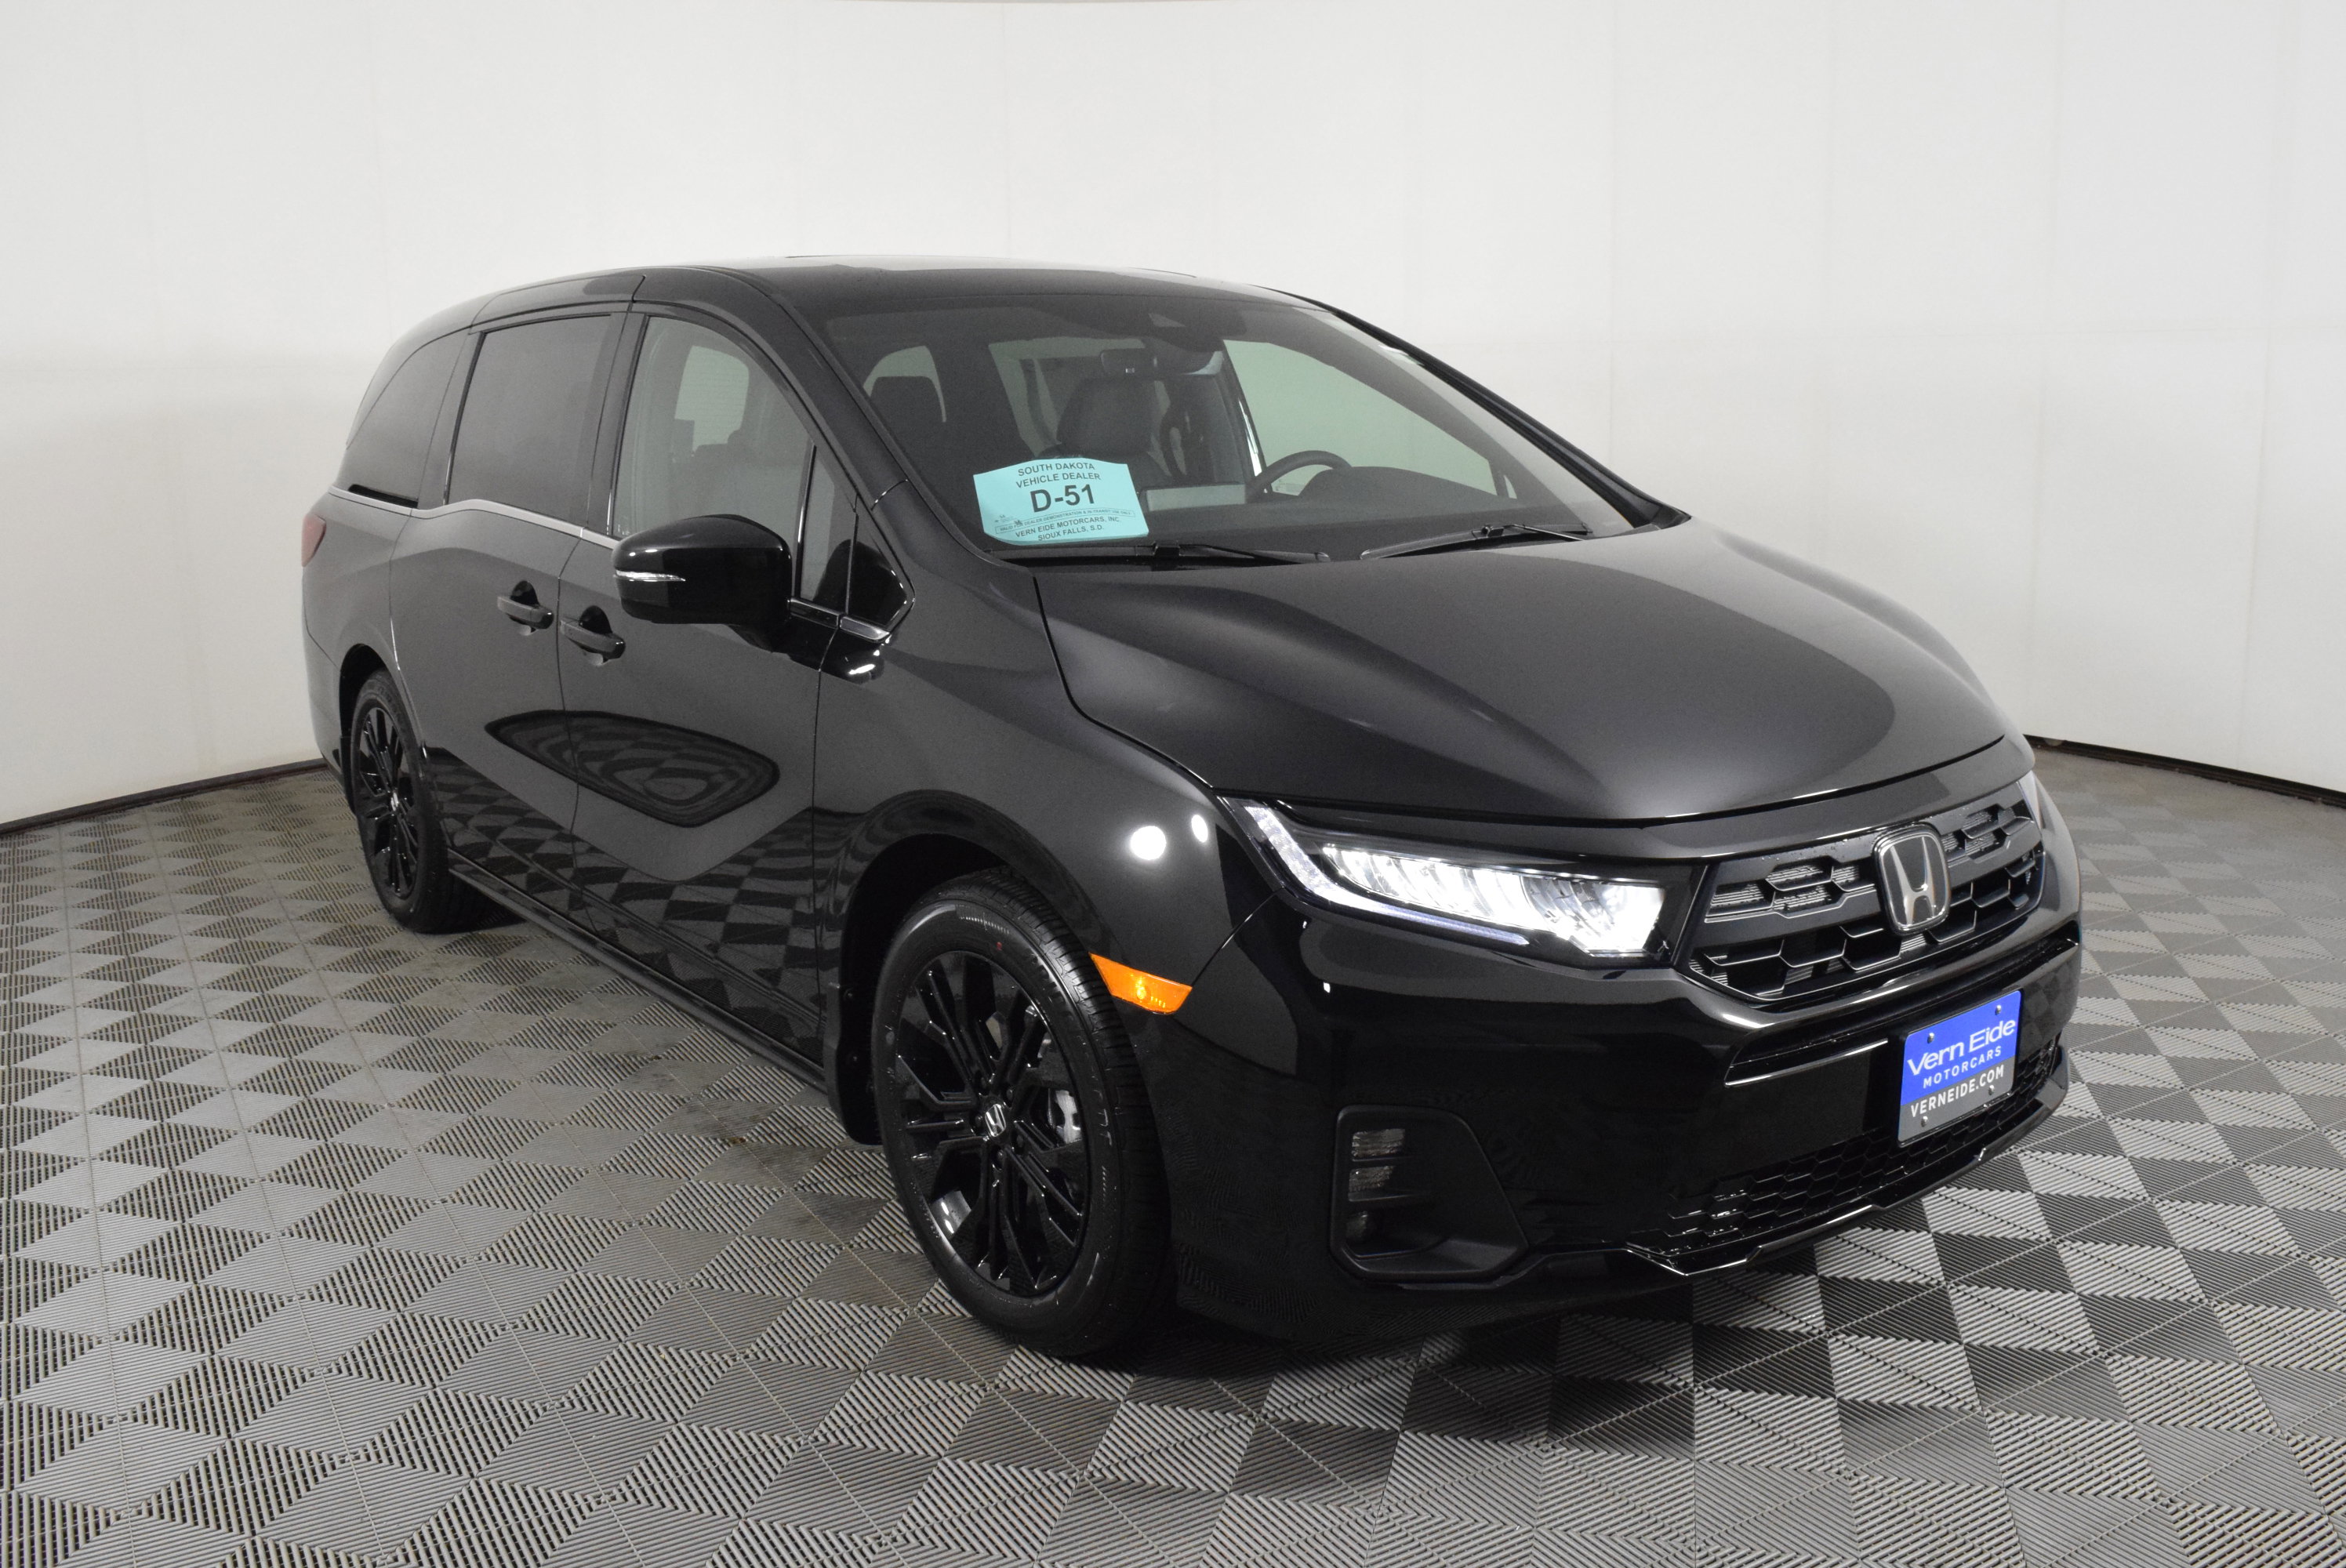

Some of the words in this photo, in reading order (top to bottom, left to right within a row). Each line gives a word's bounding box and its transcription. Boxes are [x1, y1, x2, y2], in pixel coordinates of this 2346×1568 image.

[1016, 474, 1059, 488] VEHICLE
[1062, 472, 1101, 481] DEALER
[1018, 463, 1053, 477] SOUTH
[1030, 484, 1095, 513] D-51
[1043, 510, 1082, 521] DEMONSTRATION
[1016, 528, 1036, 538] VERN
[1057, 516, 1107, 528] MOTORCARS,
[1038, 532, 1062, 541] SIOUX
[1063, 526, 1088, 535] FALLS,
[1907, 1042, 1964, 1076] Vern
[1969, 1020, 2016, 1053] Eide
[1923, 1046, 2002, 1089] MOTORCARS
[1910, 1064, 2004, 1118] VERNEIDE.COM
